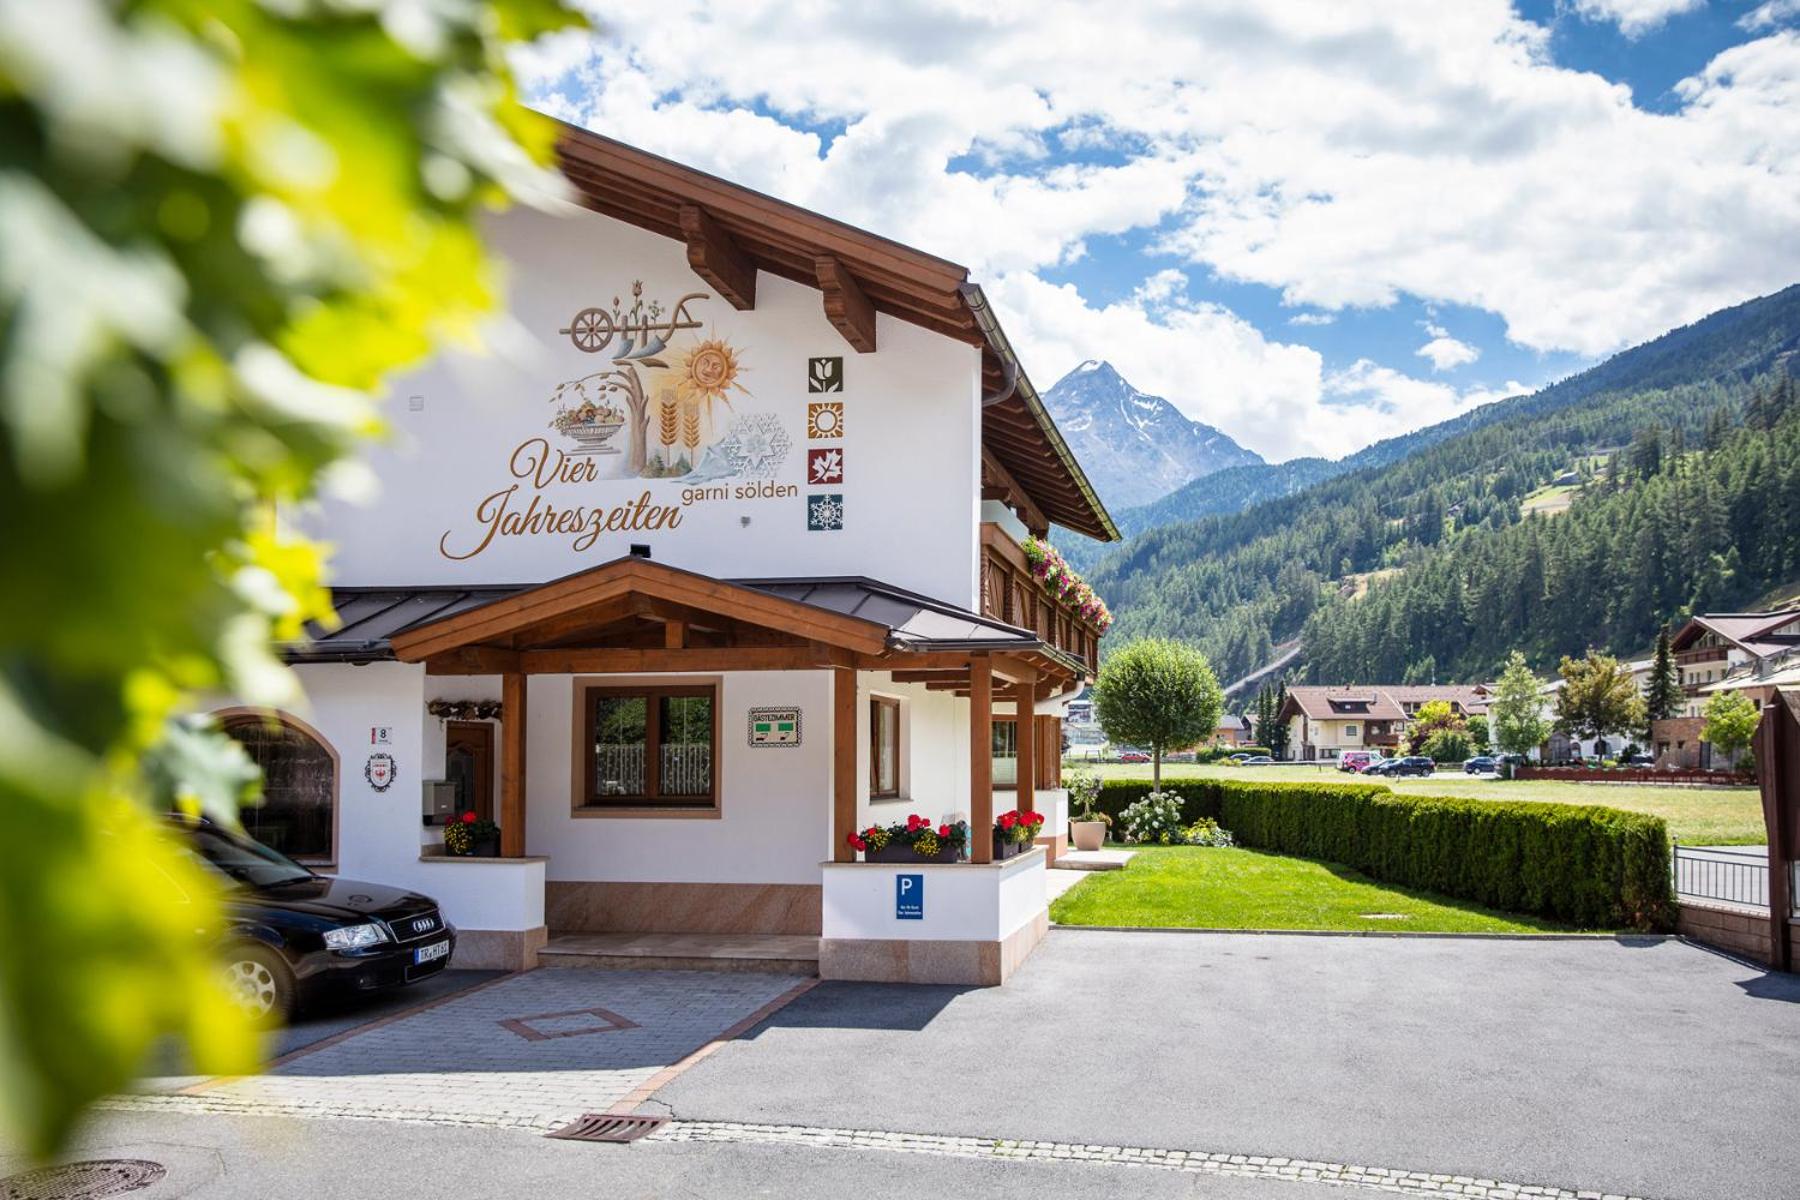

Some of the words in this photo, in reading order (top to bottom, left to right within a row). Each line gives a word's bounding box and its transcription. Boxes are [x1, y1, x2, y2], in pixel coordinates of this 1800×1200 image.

[509, 437, 599, 489] Vier
[681, 482, 729, 506] garni
[735, 480, 798, 499] sölden
[440, 484, 683, 560] Jahreszeiten
[380, 728, 387, 739] 8
[901, 877, 913, 896] P
